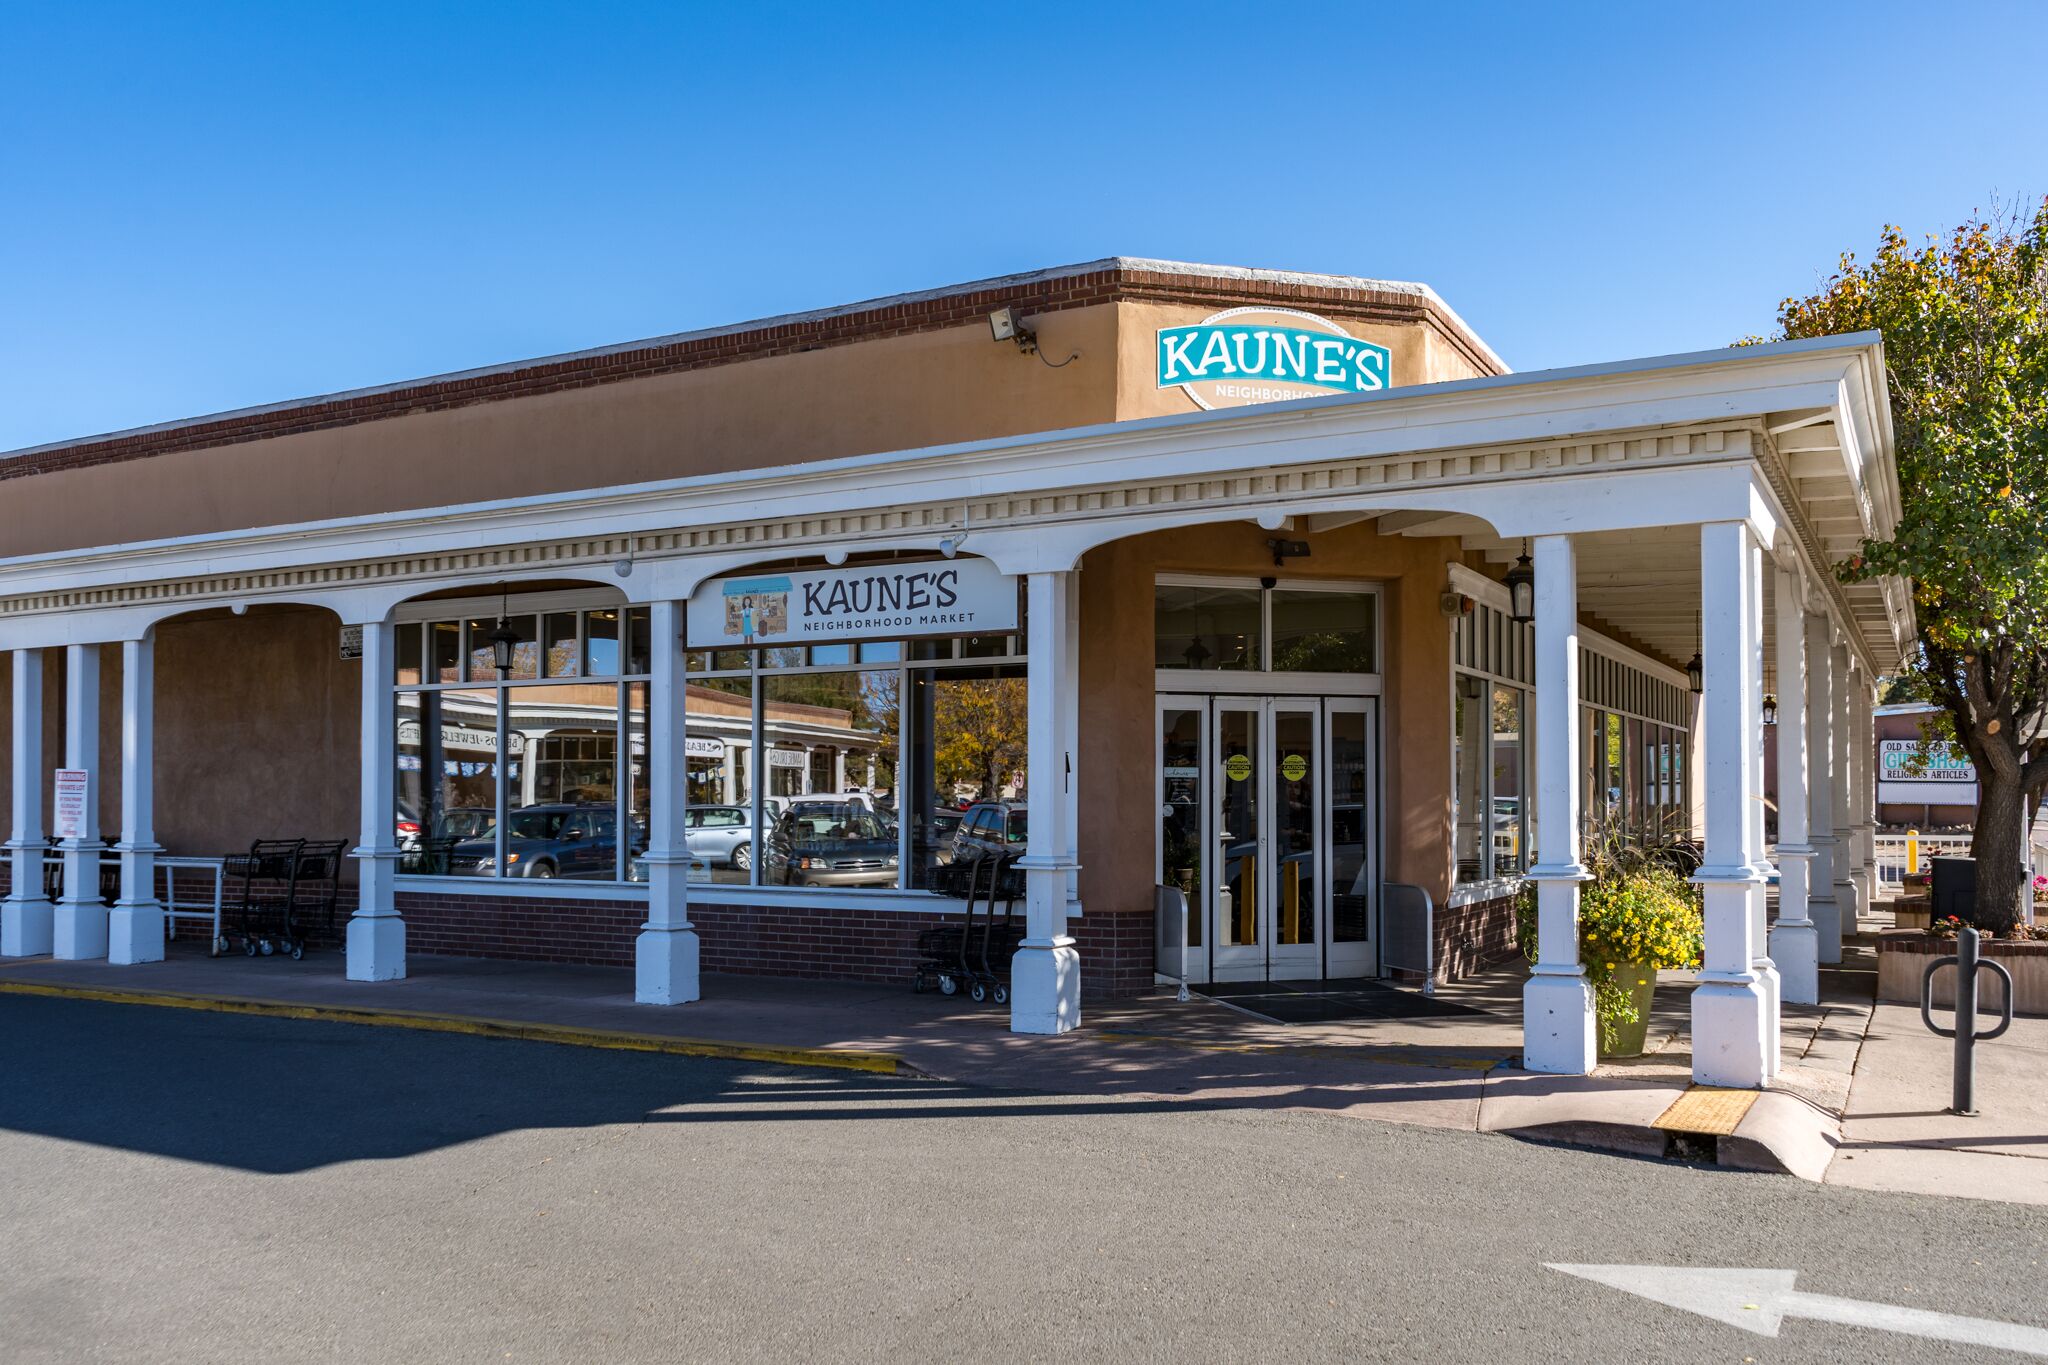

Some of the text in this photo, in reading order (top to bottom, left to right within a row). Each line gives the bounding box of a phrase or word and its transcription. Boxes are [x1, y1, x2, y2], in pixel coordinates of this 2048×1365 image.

[1162, 331, 1383, 391] KAUNE'S
[1216, 385, 1332, 401] NEIGHBORHO
[802, 570, 958, 616] KAUNE'S
[804, 612, 976, 632] NEIGHBORHOOD MARKET
[1886, 742, 1902, 751] OLD
[1931, 770, 1969, 780] ARTICLES
